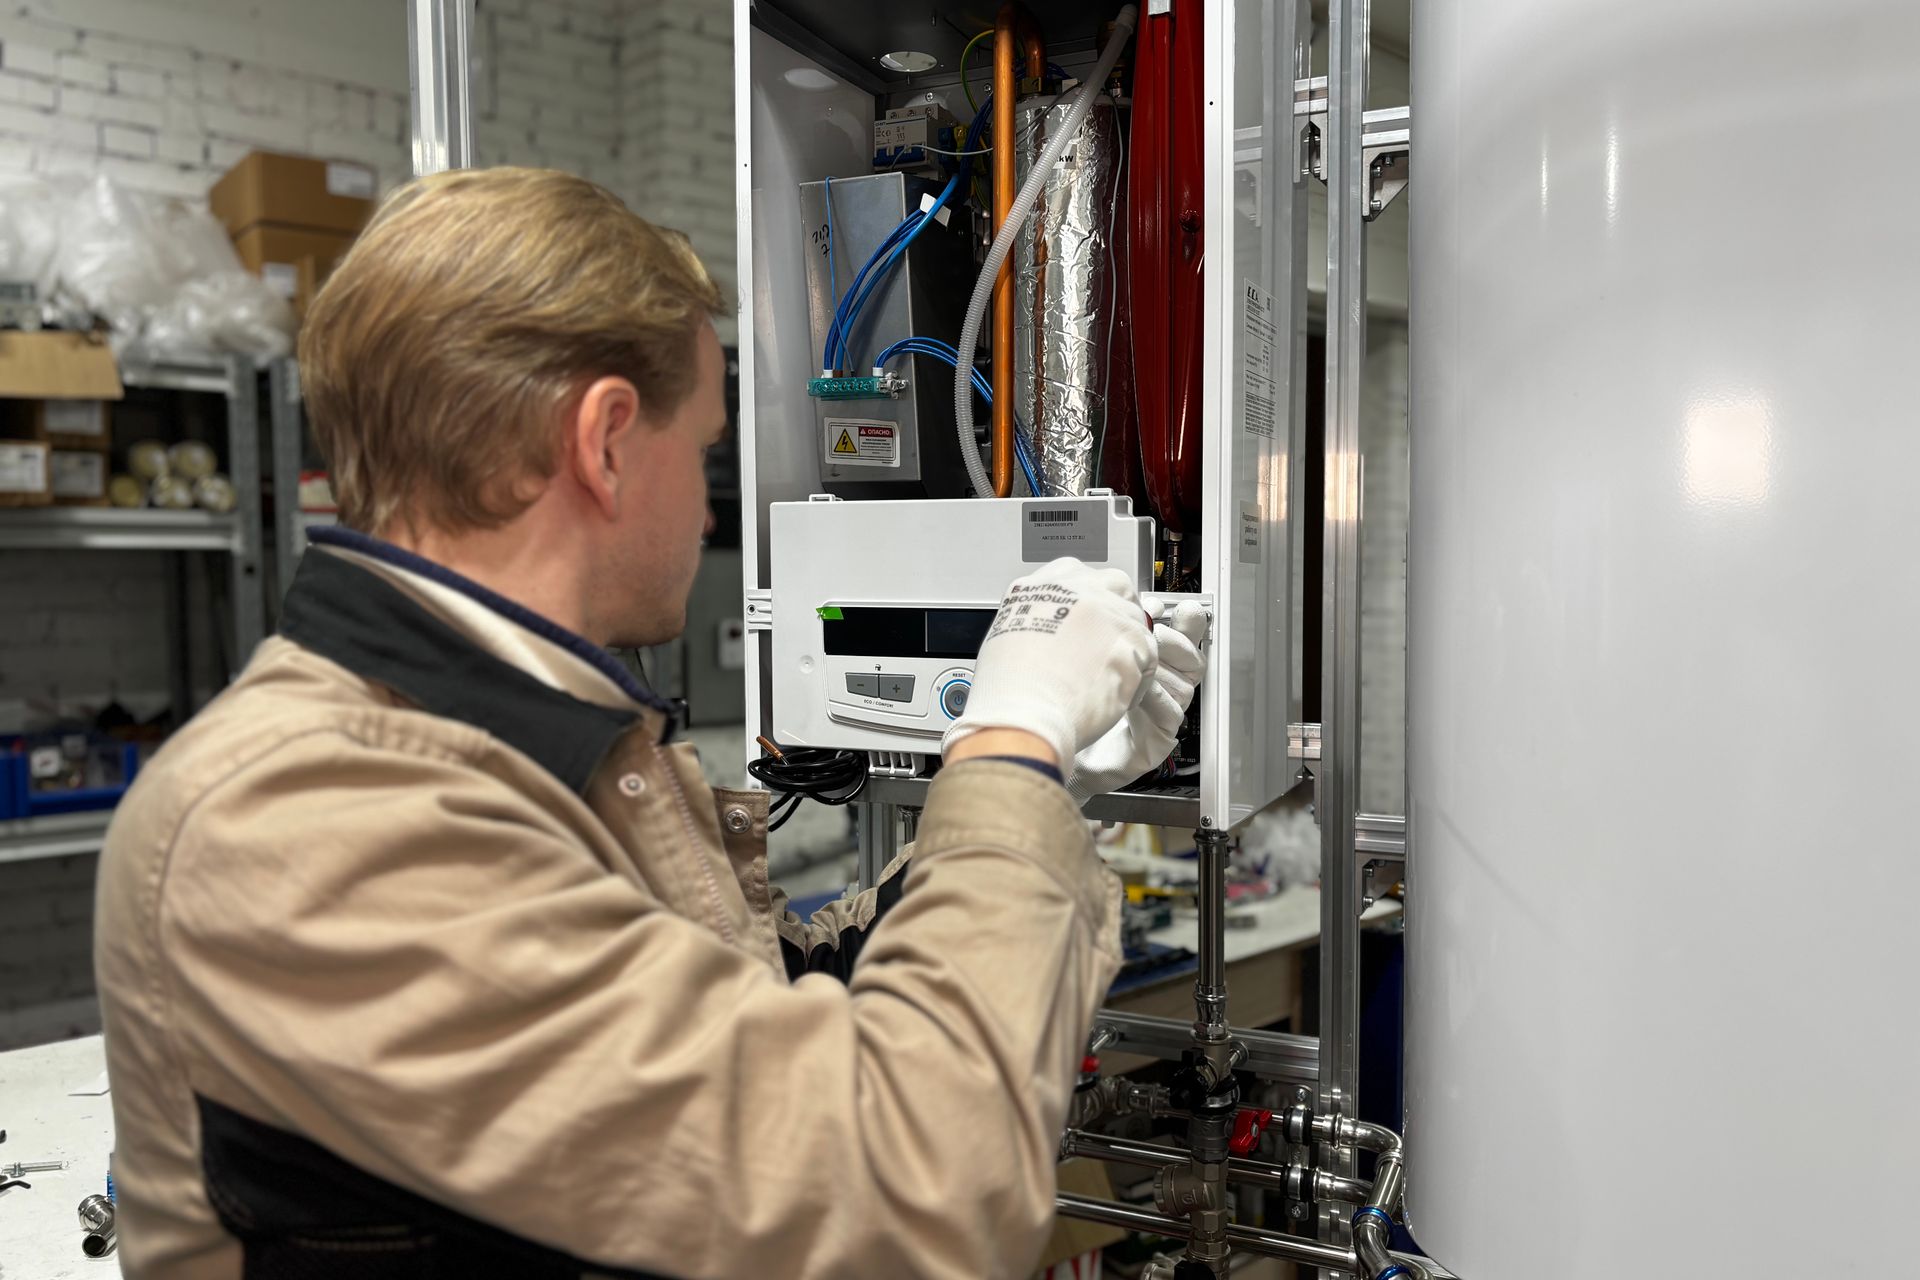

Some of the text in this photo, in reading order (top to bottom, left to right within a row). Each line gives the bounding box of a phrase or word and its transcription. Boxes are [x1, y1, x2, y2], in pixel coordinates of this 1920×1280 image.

[1011, 584, 1077, 595] БАНТИНГ
[1002, 594, 1078, 608] ЭВОЛЮШН
[1053, 607, 1070, 620] 9
